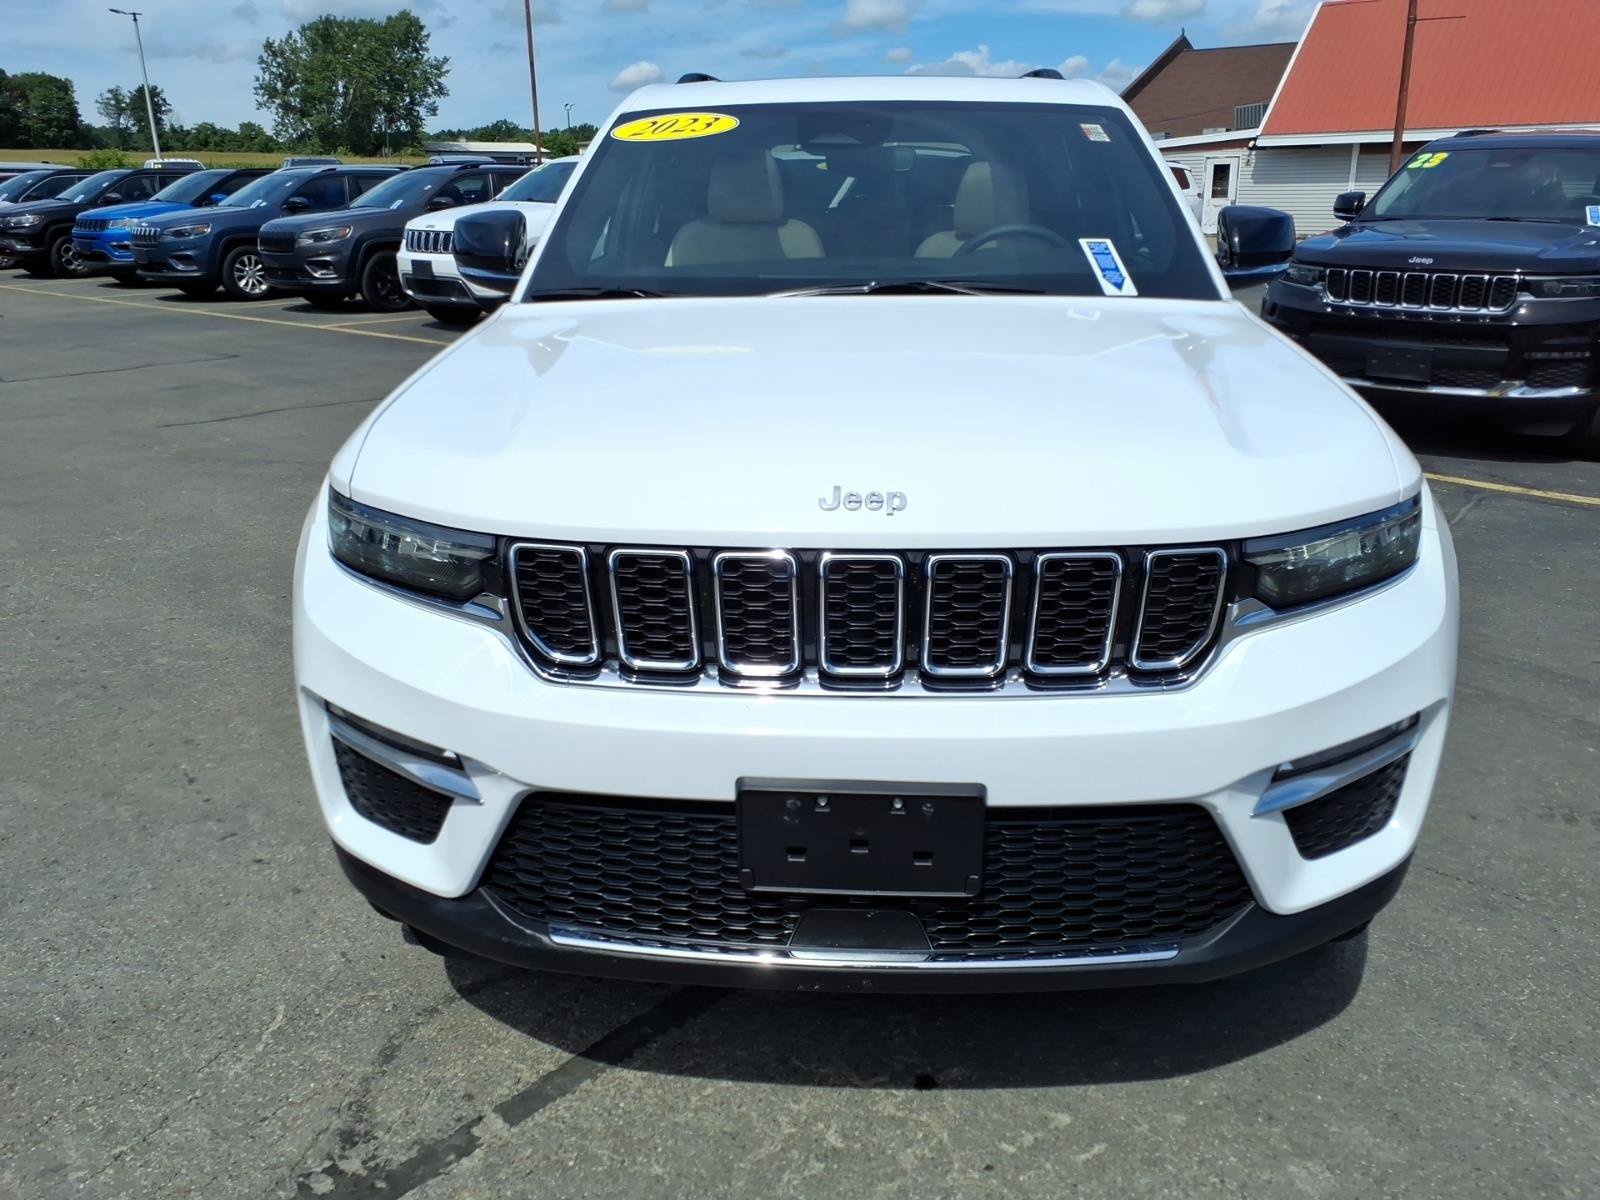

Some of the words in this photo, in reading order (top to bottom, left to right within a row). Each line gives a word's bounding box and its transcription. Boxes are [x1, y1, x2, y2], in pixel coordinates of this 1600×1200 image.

[629, 117, 720, 136] 2023
[1407, 152, 1449, 169] 23
[1408, 256, 1434, 265] Jeep
[818, 485, 908, 516] Jeep
